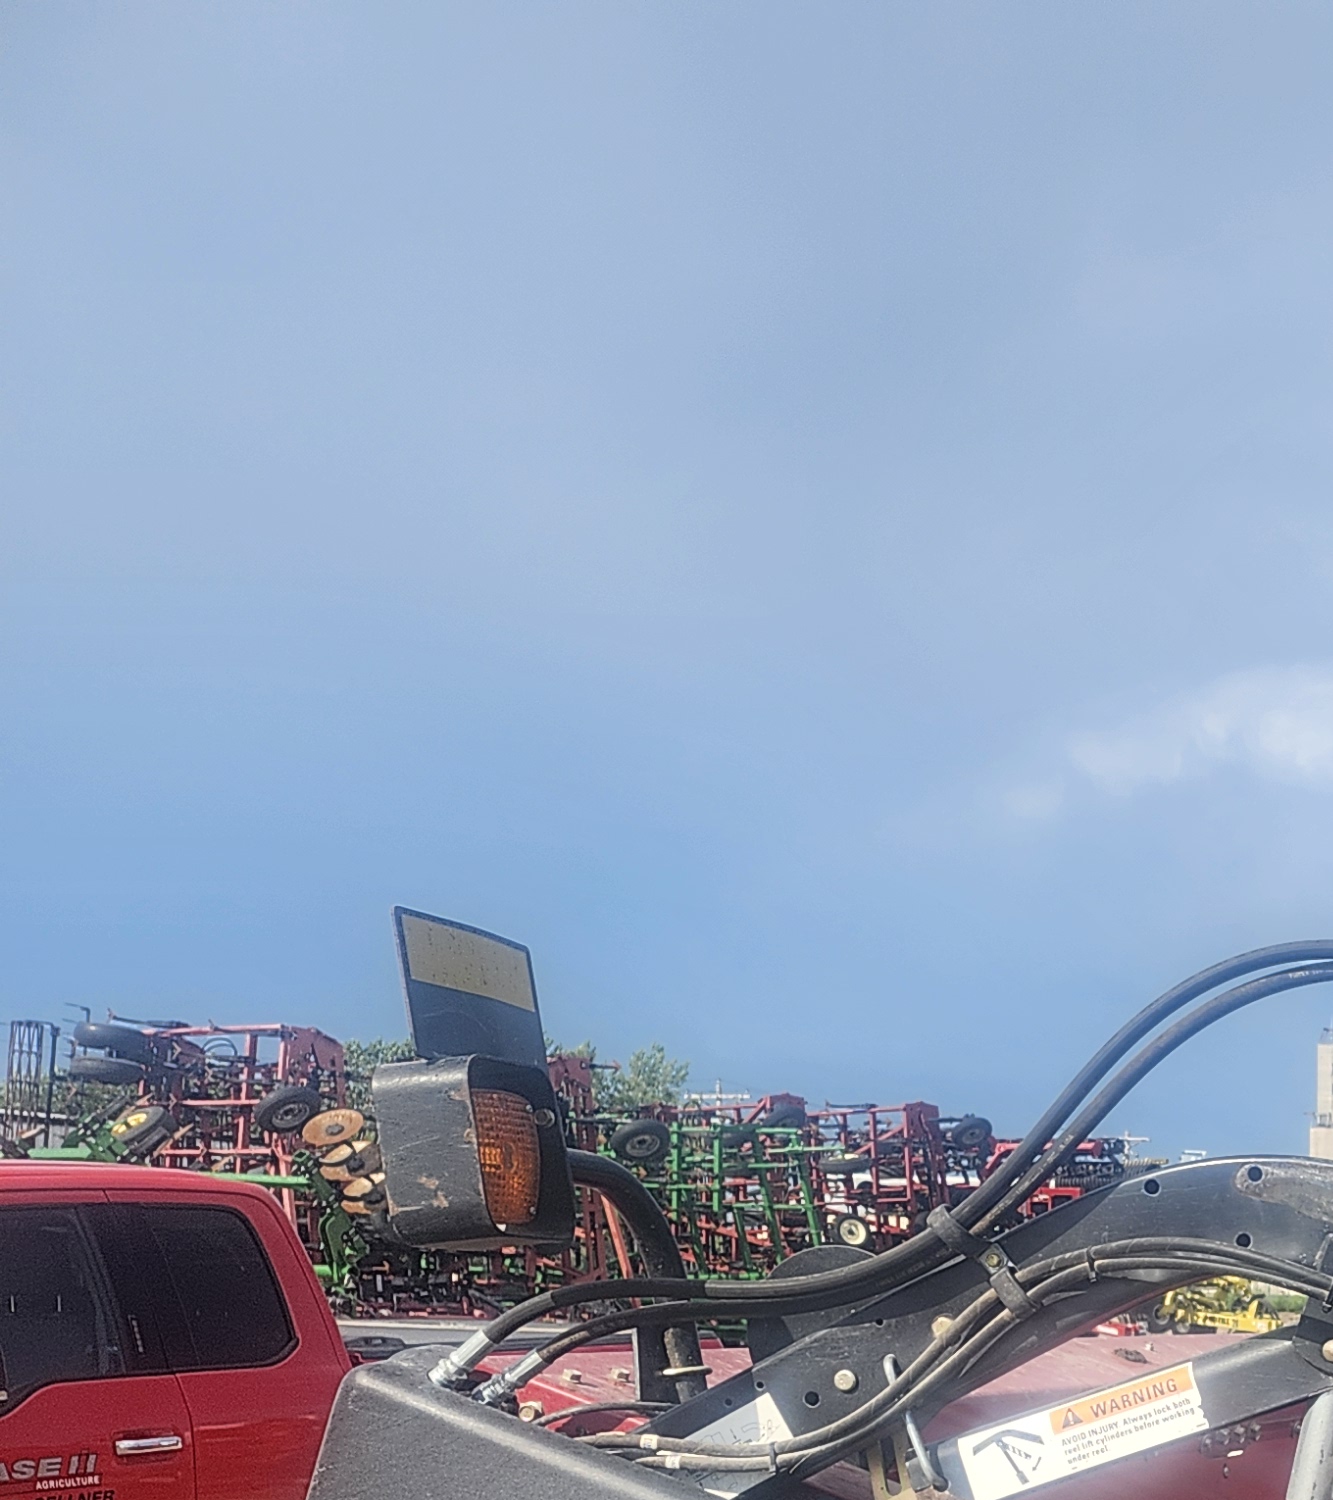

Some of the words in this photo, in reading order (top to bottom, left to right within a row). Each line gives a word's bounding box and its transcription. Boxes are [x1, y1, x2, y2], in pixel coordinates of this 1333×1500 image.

[1090, 1378, 1178, 1418] WARNING
[1061, 1432, 1086, 1446] AVOID
[1122, 1411, 1152, 1428] Always
[1154, 1404, 1171, 1416] lock
[1172, 1397, 1191, 1409] both
[1064, 1444, 1081, 1456] reel
[1082, 1439, 1094, 1450] lift
[1095, 1428, 1133, 1447] cylinders
[1135, 1419, 1160, 1433] before
[1162, 1406, 1196, 1423] working
[1067, 1452, 1090, 1464] under
[36, 1475, 100, 1490] AGRICULTURE
